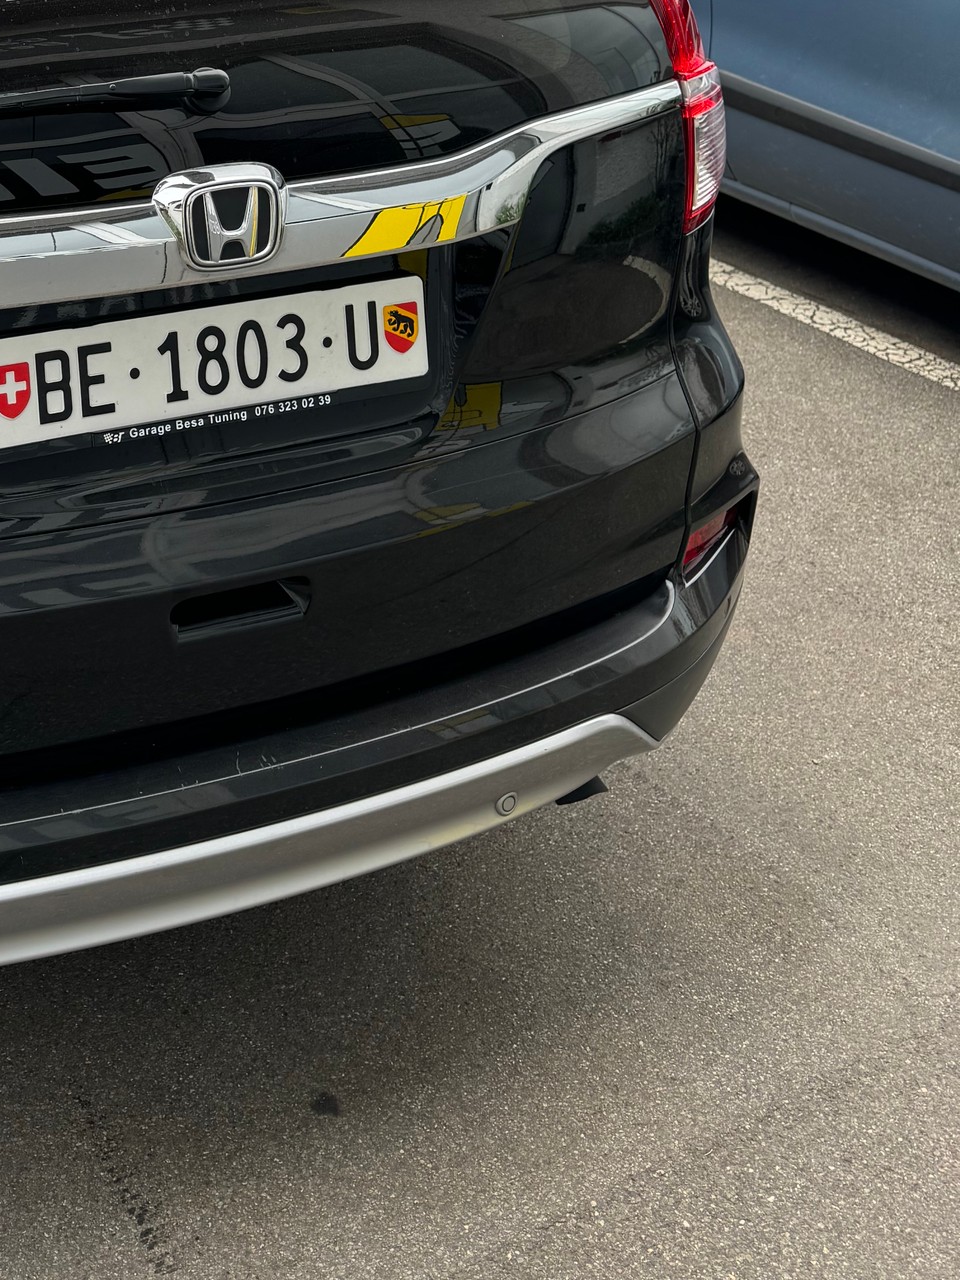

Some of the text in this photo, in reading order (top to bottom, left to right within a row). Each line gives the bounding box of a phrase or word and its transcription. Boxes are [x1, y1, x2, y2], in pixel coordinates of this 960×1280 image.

[129, 423, 171, 439] Garage
[176, 418, 204, 430] Besa
[208, 410, 247, 425] Tuning
[254, 404, 274, 417] 076
[278, 399, 298, 413] 323
[301, 397, 315, 409] 02
[318, 394, 331, 406] 39
